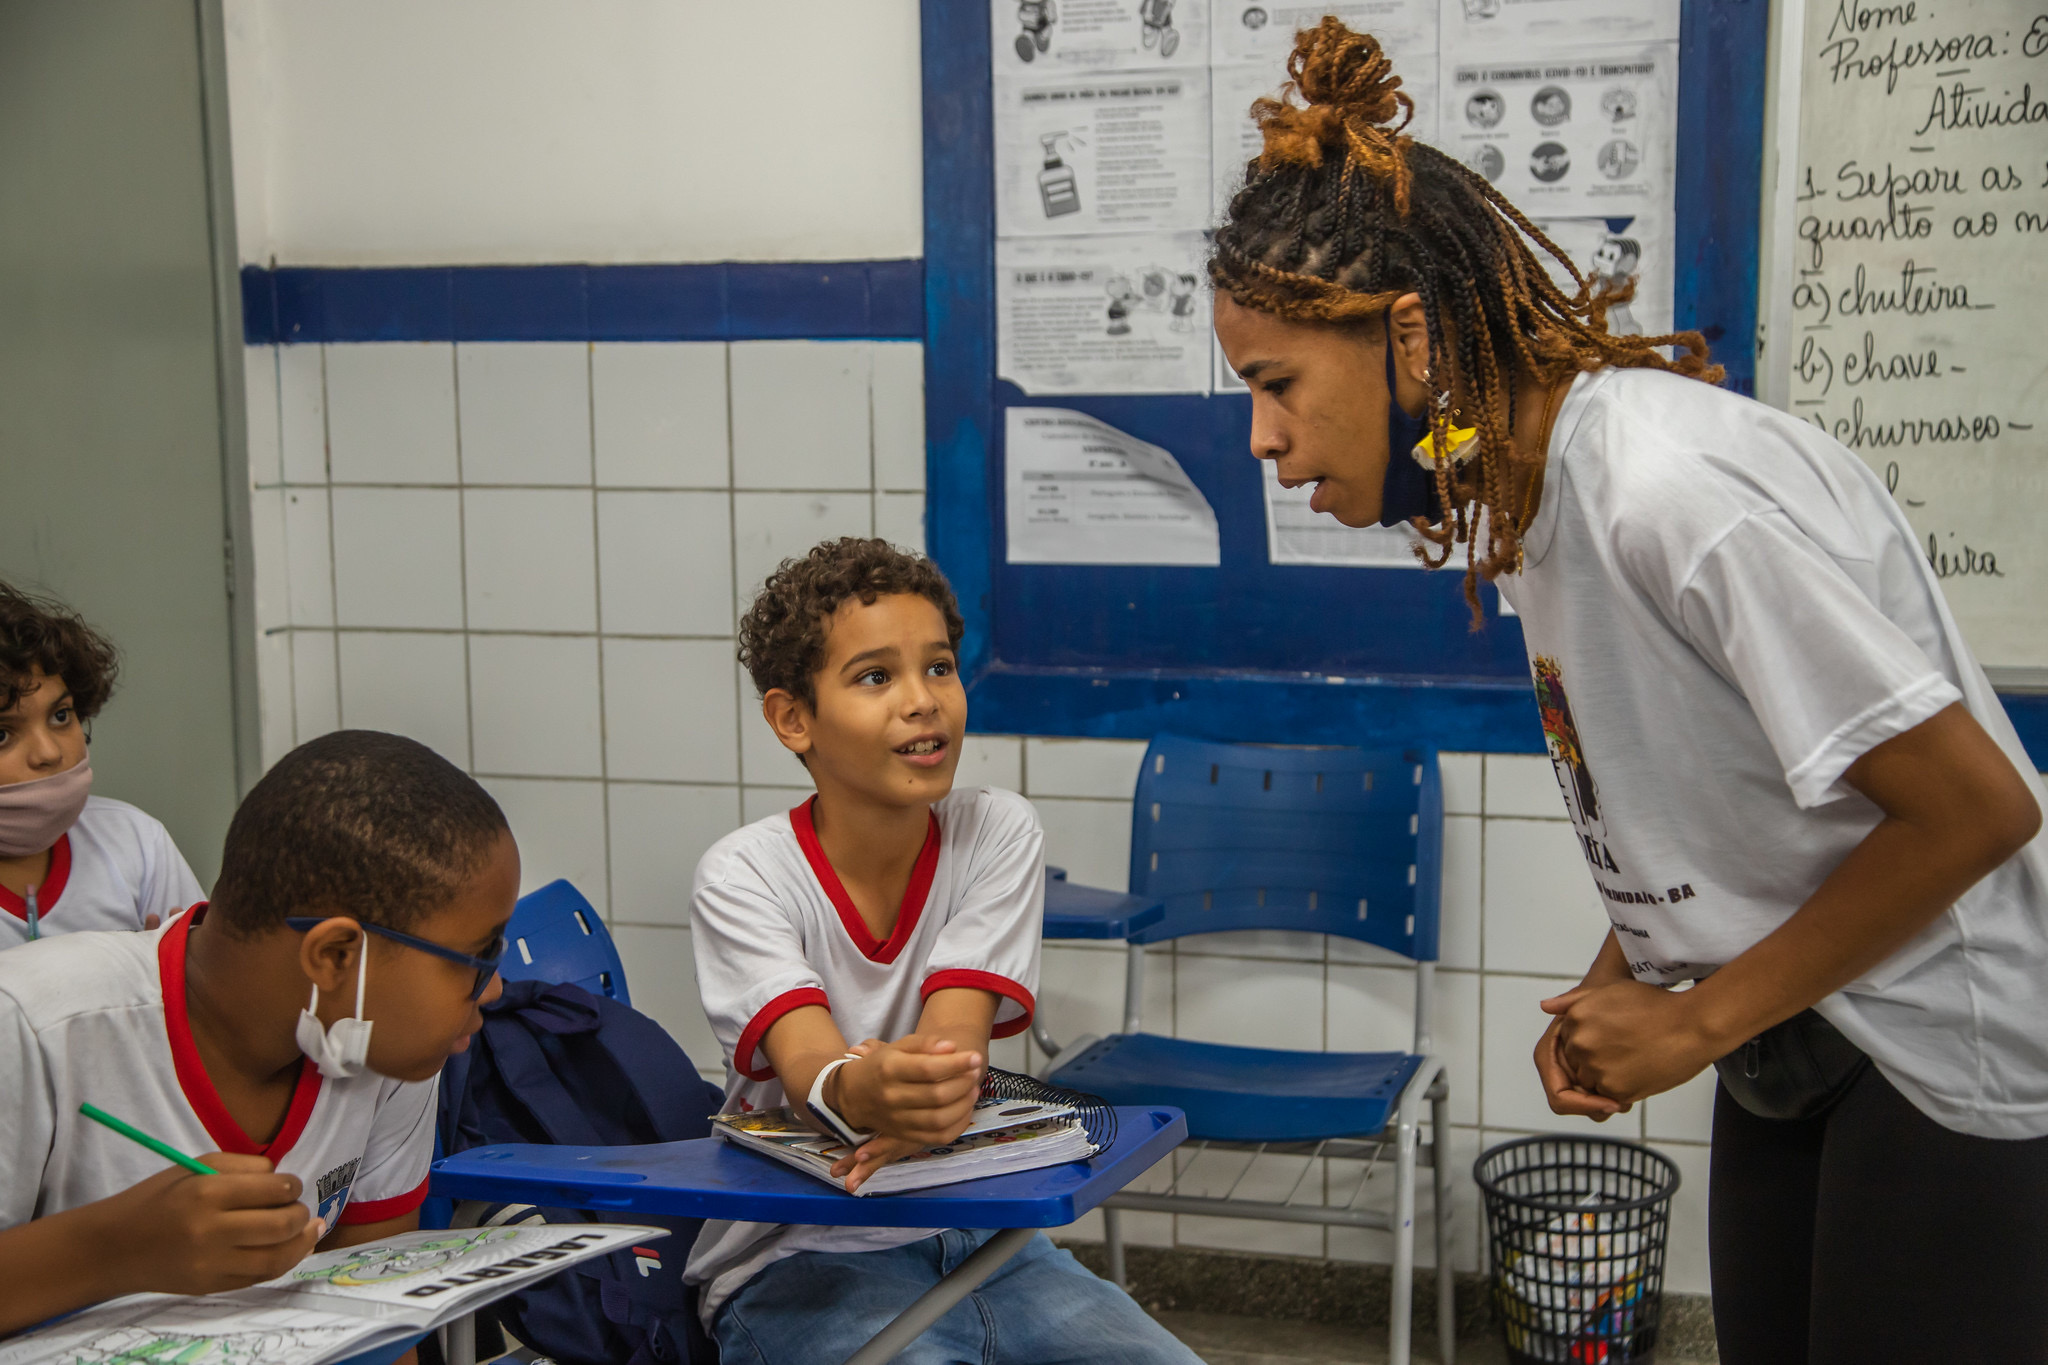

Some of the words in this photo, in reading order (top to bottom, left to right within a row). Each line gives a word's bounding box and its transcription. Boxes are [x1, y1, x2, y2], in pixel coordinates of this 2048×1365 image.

[1837, 160, 1967, 224] Separe
[1982, 164, 2022, 191] as
[1799, 202, 1935, 270] quanto
[1953, 211, 1998, 239] ao
[402, 1233, 608, 1297] LAGARTO
